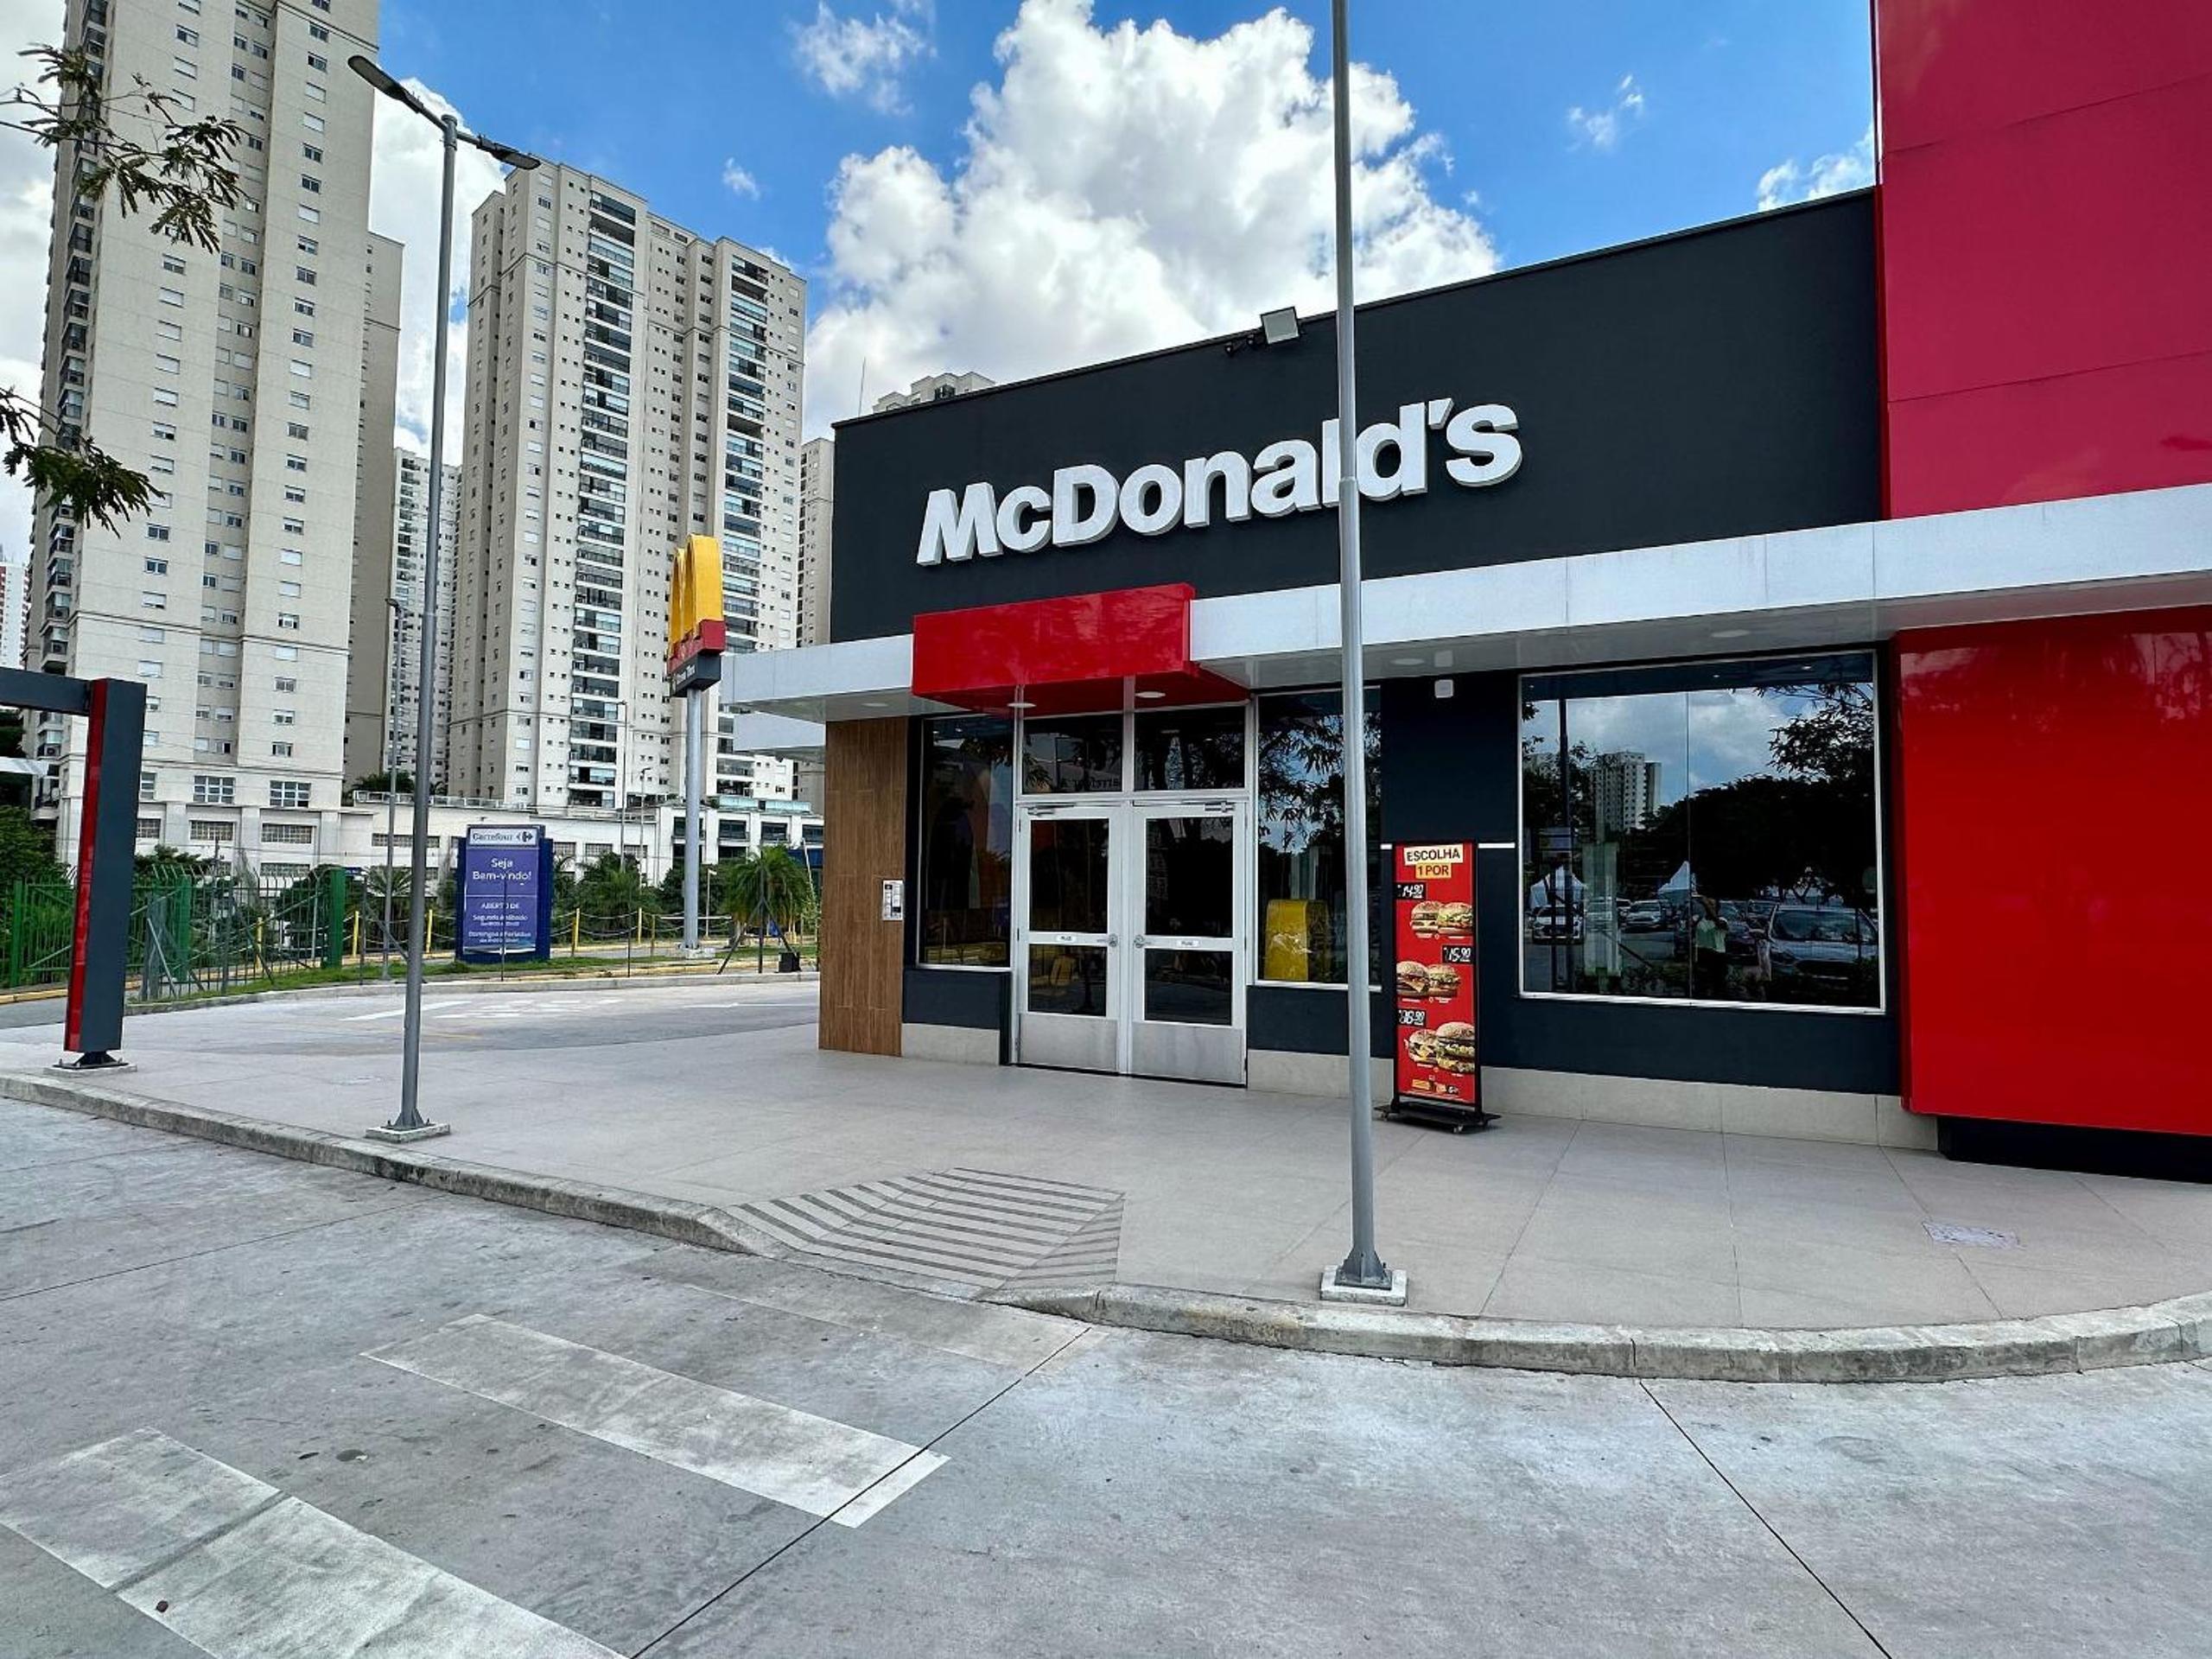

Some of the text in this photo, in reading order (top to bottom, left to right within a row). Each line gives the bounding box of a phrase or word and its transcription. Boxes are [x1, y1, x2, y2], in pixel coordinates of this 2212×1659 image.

[917, 397, 1522, 567] McDonald's
[1406, 848, 1461, 862] ESCOLHA
[490, 857, 513, 869] Seja
[1417, 865, 1449, 875] 1 POR
